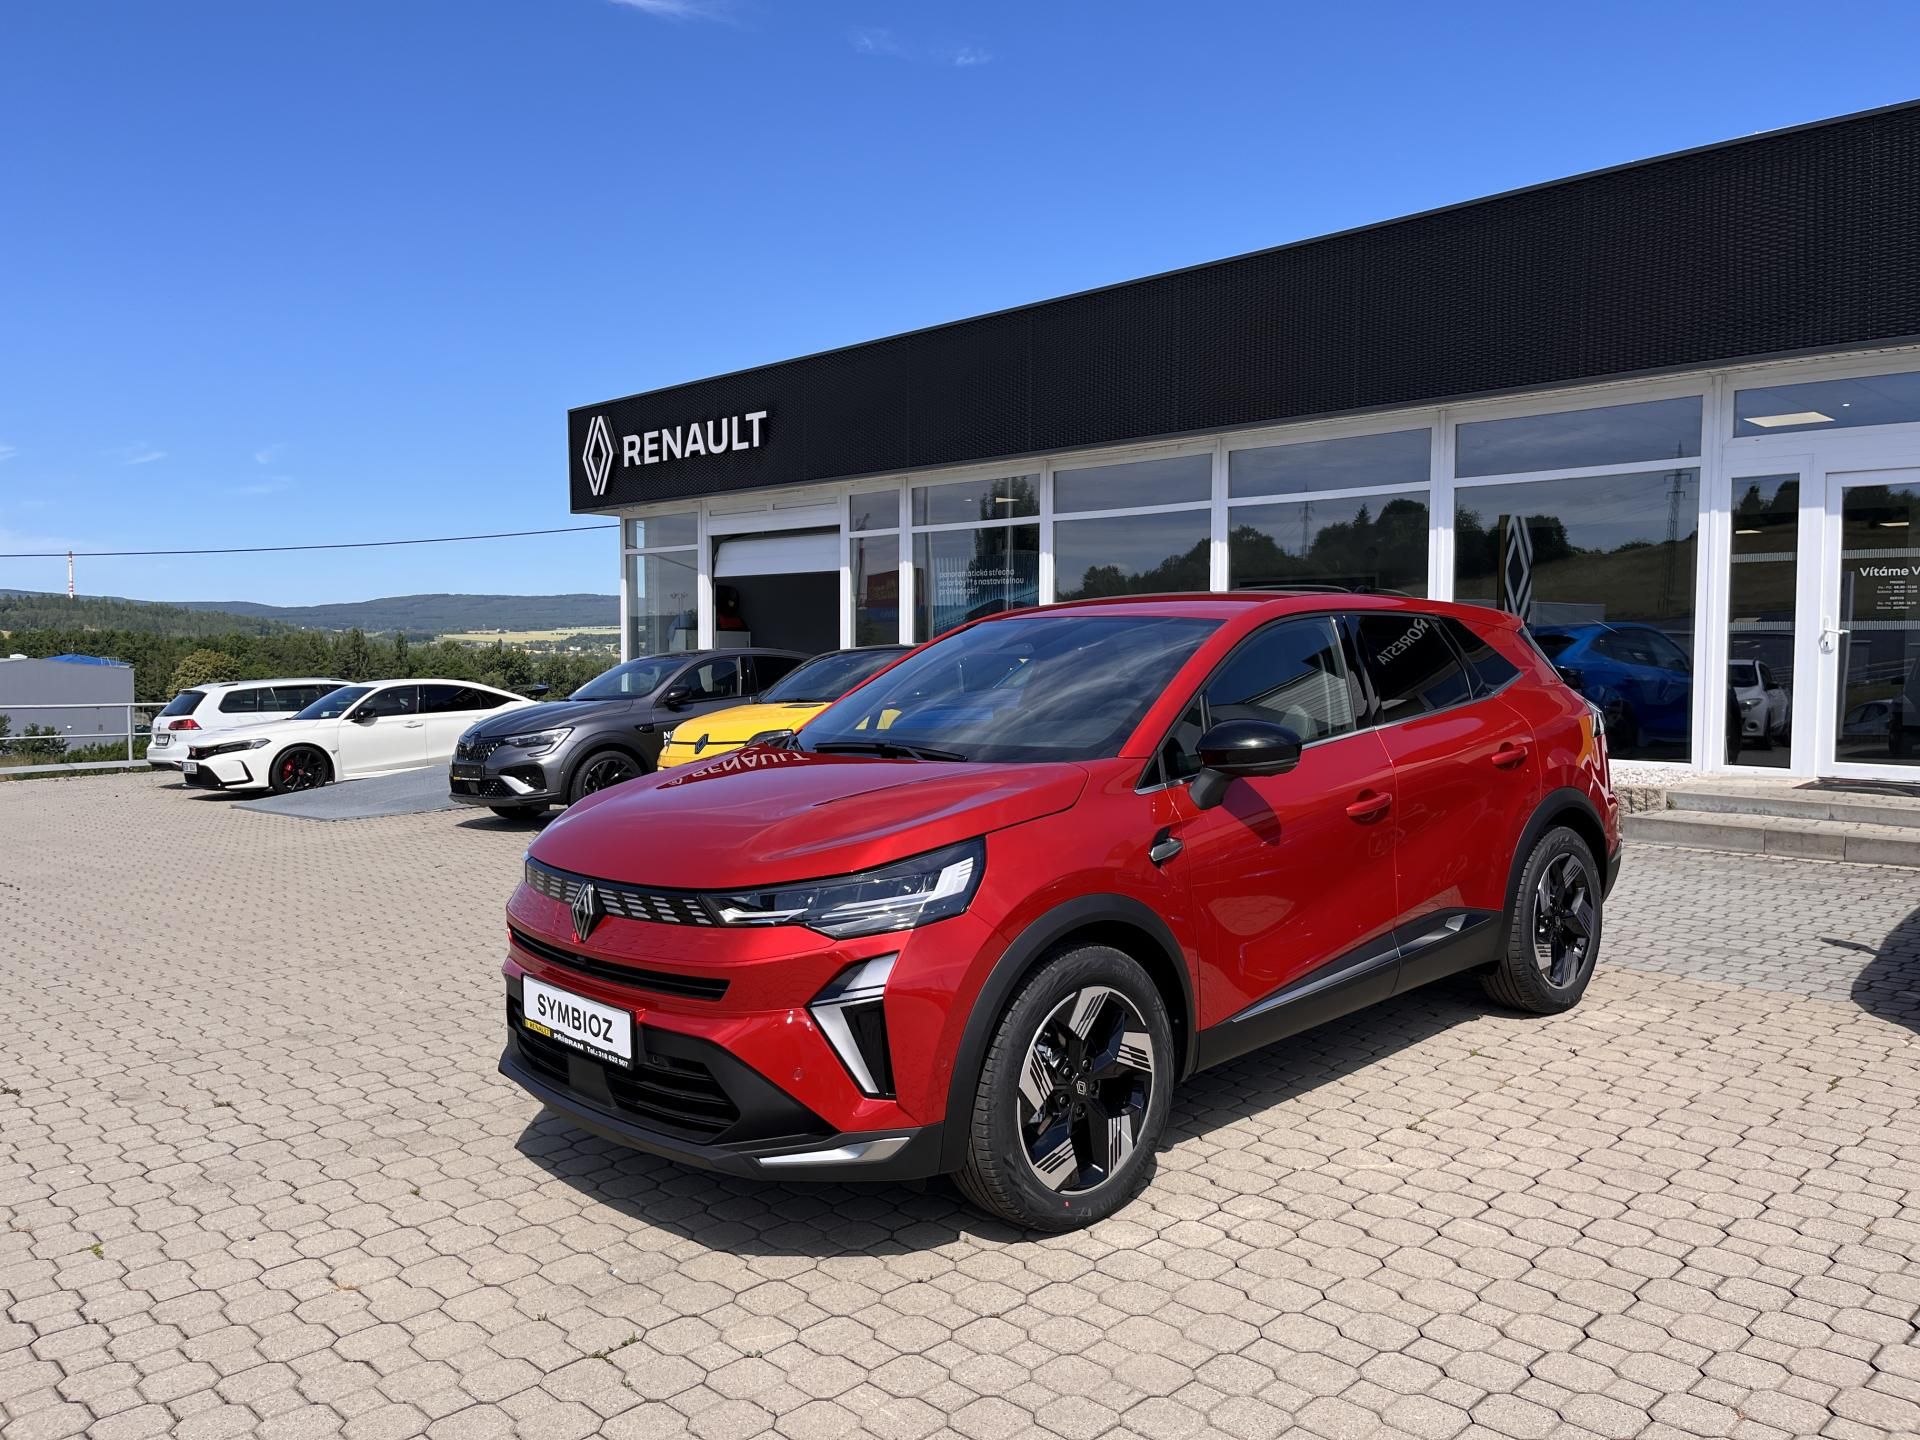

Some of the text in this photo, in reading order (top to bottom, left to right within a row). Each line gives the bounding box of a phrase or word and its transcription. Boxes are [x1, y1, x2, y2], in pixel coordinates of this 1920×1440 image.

[623, 410, 767, 468] RENAULT
[989, 567, 1015, 577] střecha
[1860, 566, 1909, 577] Vítáme
[979, 576, 1025, 586] nastavitelnou
[537, 993, 614, 1044] SYMBIOZ
